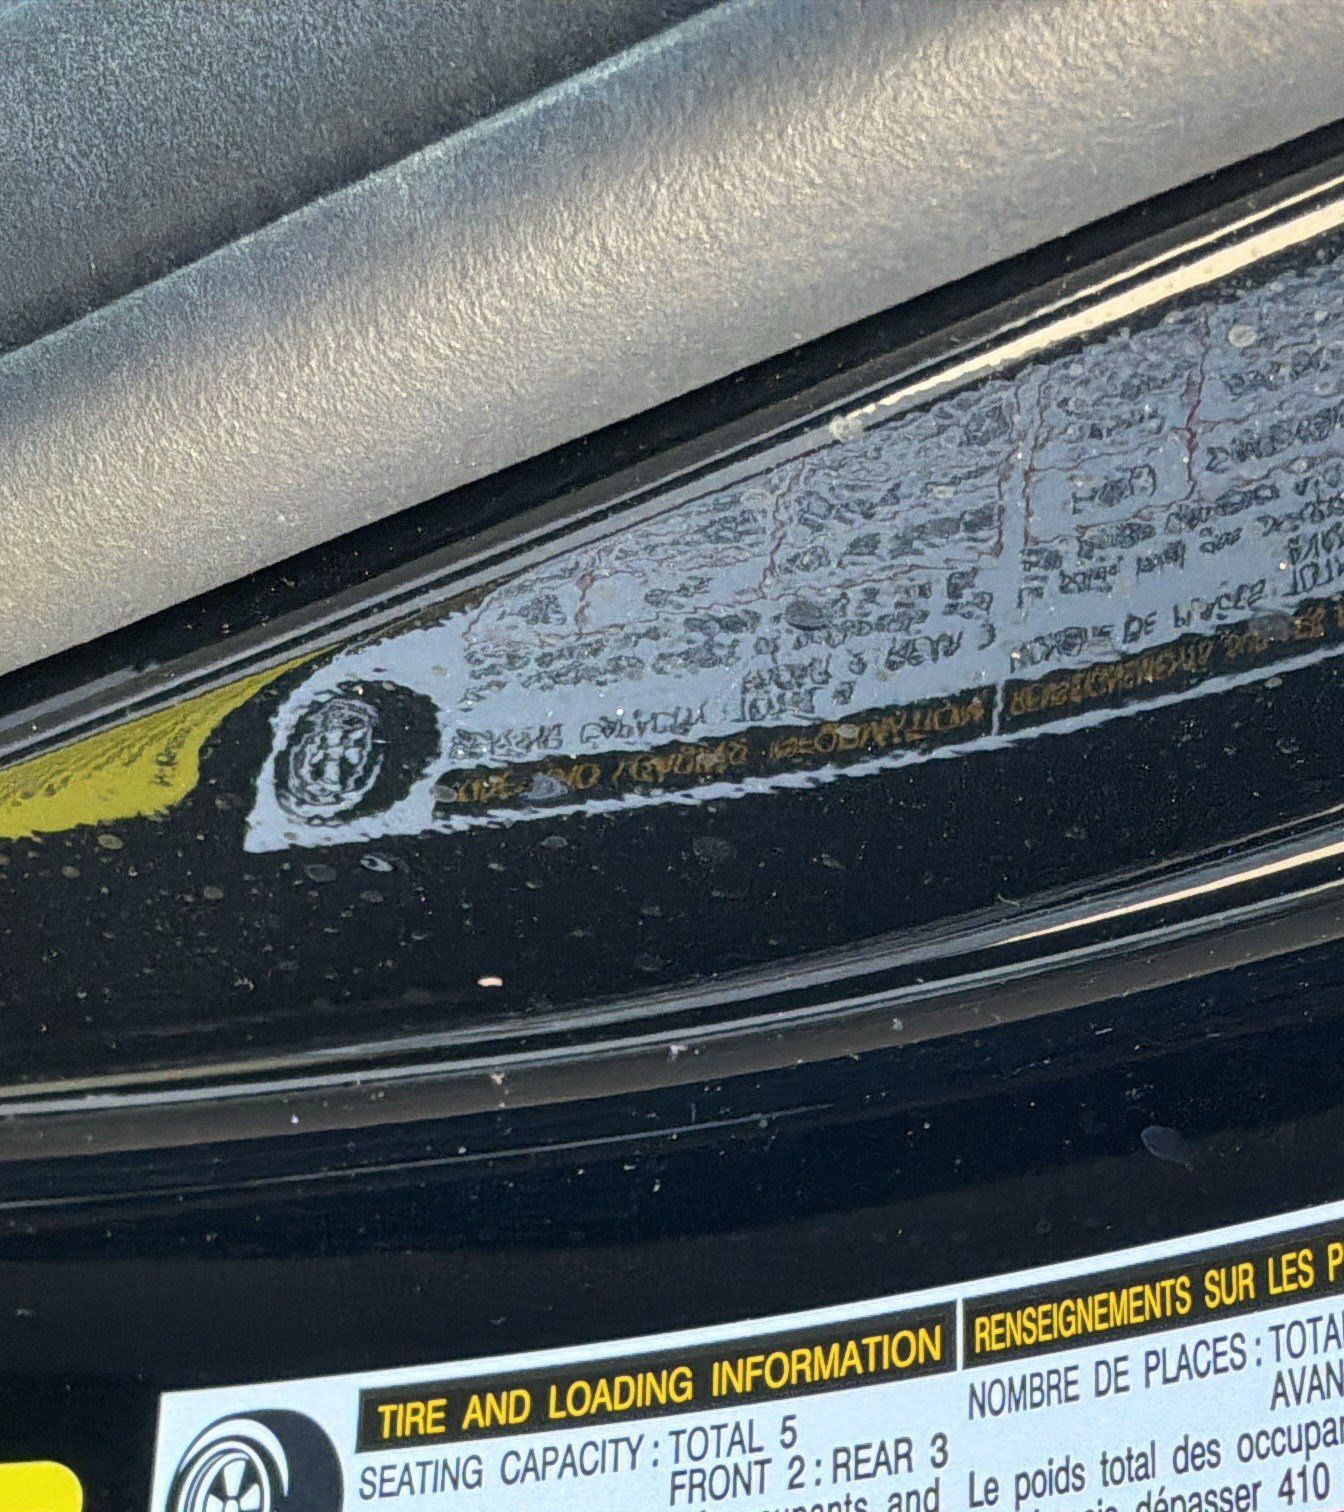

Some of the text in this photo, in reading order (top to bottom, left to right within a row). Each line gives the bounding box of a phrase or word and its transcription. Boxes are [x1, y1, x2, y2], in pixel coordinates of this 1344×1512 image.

[974, 1274, 1191, 1353] RENSEIGNEMENTS
[1203, 1261, 1255, 1308] SUR
[1267, 1247, 1314, 1295] LES
[377, 1324, 940, 1439] TIRE AND LOADING INFORMATION
[968, 1364, 1080, 1420] NOMBRE
[1094, 1354, 1130, 1398] DE
[358, 1413, 797, 1501] SEATING TOTAL 5
[669, 1431, 948, 1506] FRONT REAR 3
[968, 1469, 999, 1509] Le
[1014, 1454, 1085, 1509] poids
[1099, 1439, 1156, 1487] total
[1172, 1433, 1221, 1475] des
[1277, 1461, 1330, 1505] 410
